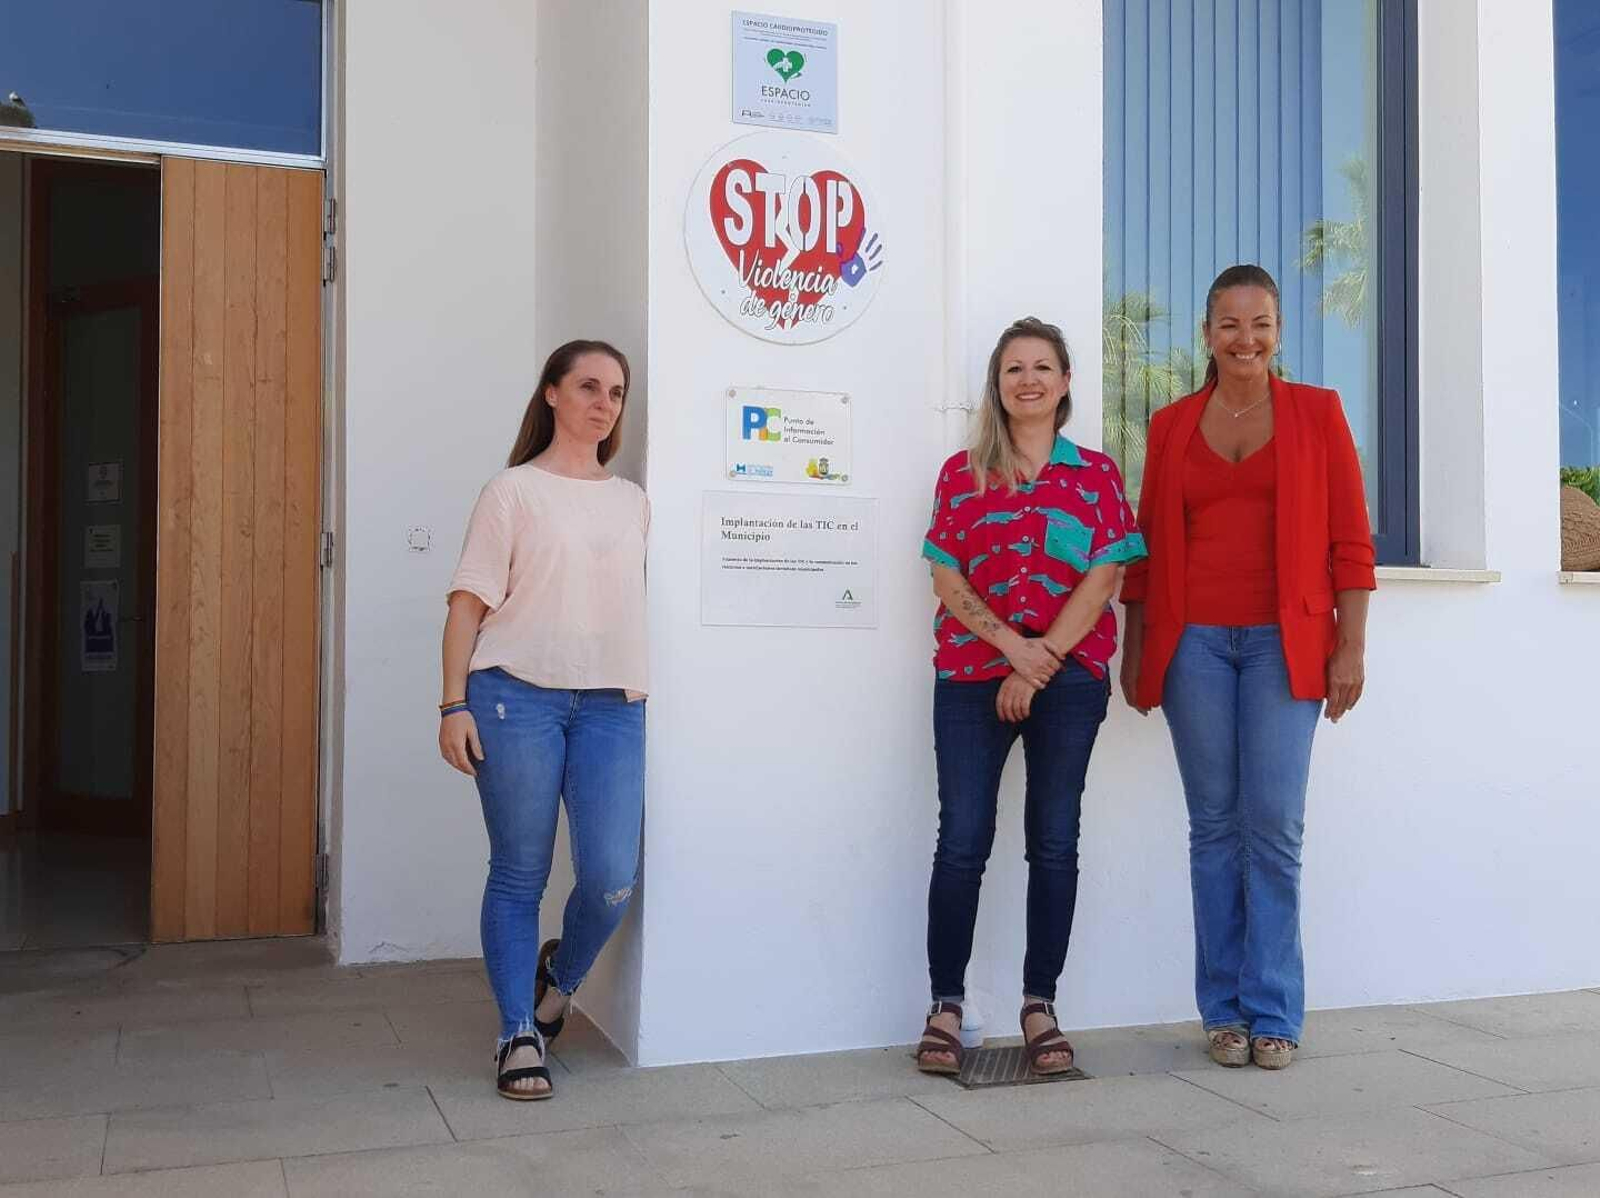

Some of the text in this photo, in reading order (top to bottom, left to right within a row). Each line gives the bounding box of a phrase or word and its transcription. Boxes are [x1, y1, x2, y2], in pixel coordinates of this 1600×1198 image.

[742, 20, 768, 29] ESPACIO
[761, 85, 810, 101] ESPACIO
[724, 169, 853, 253] STOP
[739, 249, 838, 295] Violencia
[740, 290, 764, 318] de
[783, 416, 815, 426] Punto de
[783, 426, 826, 436] Información
[783, 435, 834, 446] al Consumidor
[720, 516, 859, 531] Implantación de las TIC en el
[721, 531, 771, 543] Municipio
